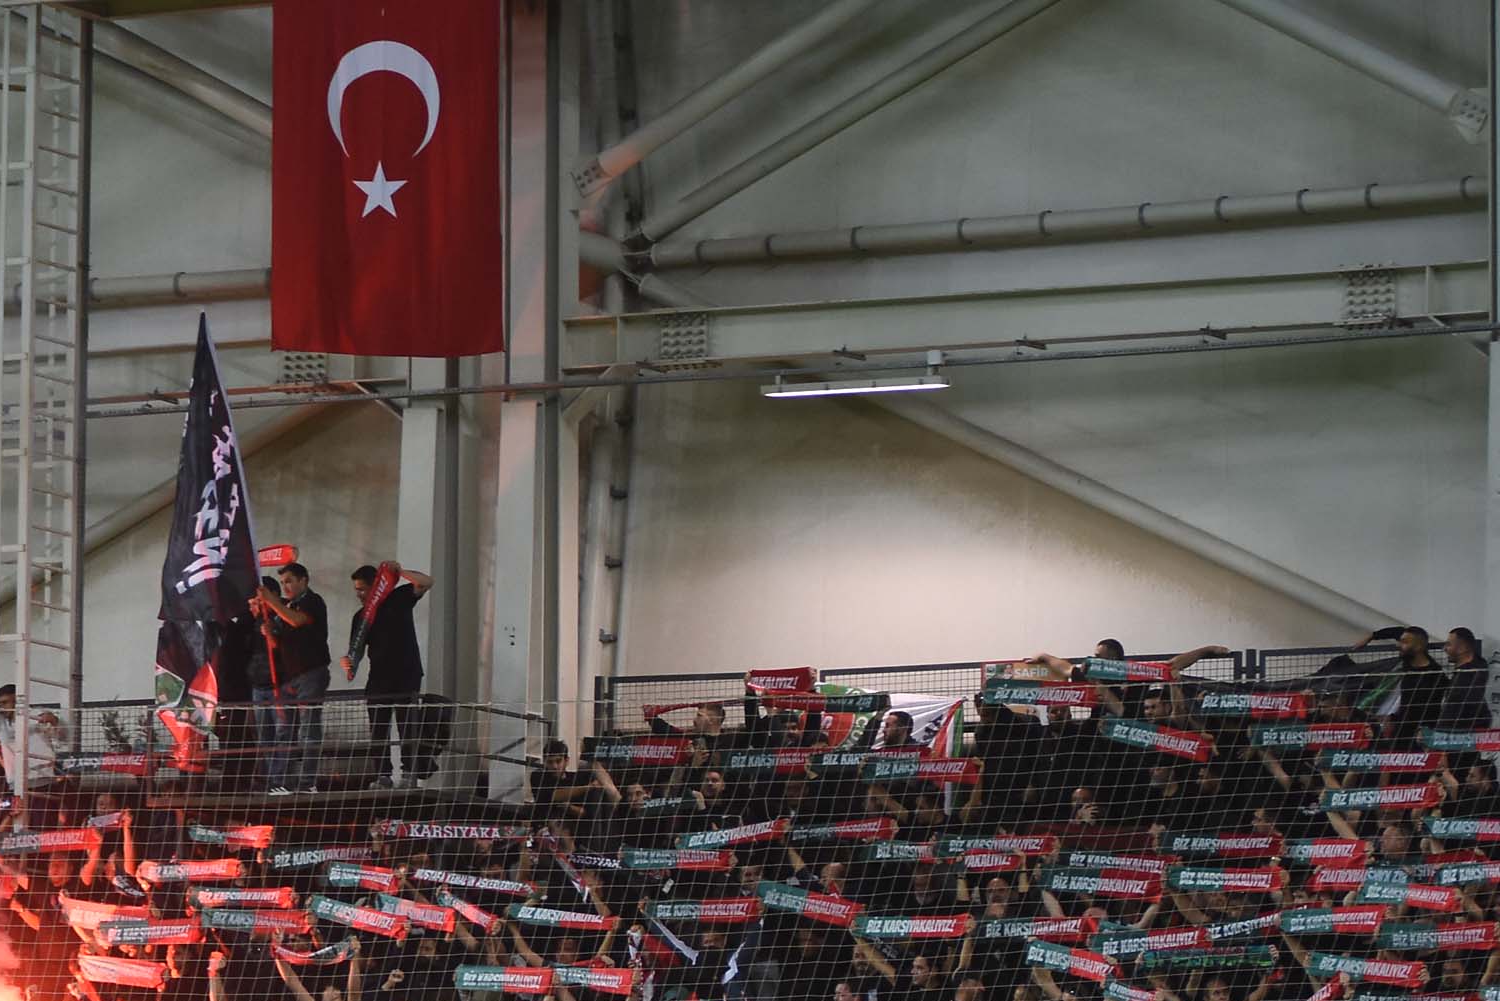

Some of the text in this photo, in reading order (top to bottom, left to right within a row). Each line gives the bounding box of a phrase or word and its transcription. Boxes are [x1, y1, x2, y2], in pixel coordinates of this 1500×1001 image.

[1332, 751, 1348, 766] BİZ
[1332, 790, 1348, 805] BİZ
[1173, 835, 1190, 849] BİZ
[1180, 871, 1196, 887] BİZ
[867, 917, 882, 932] BİZ
[1319, 956, 1335, 971] BİZ
